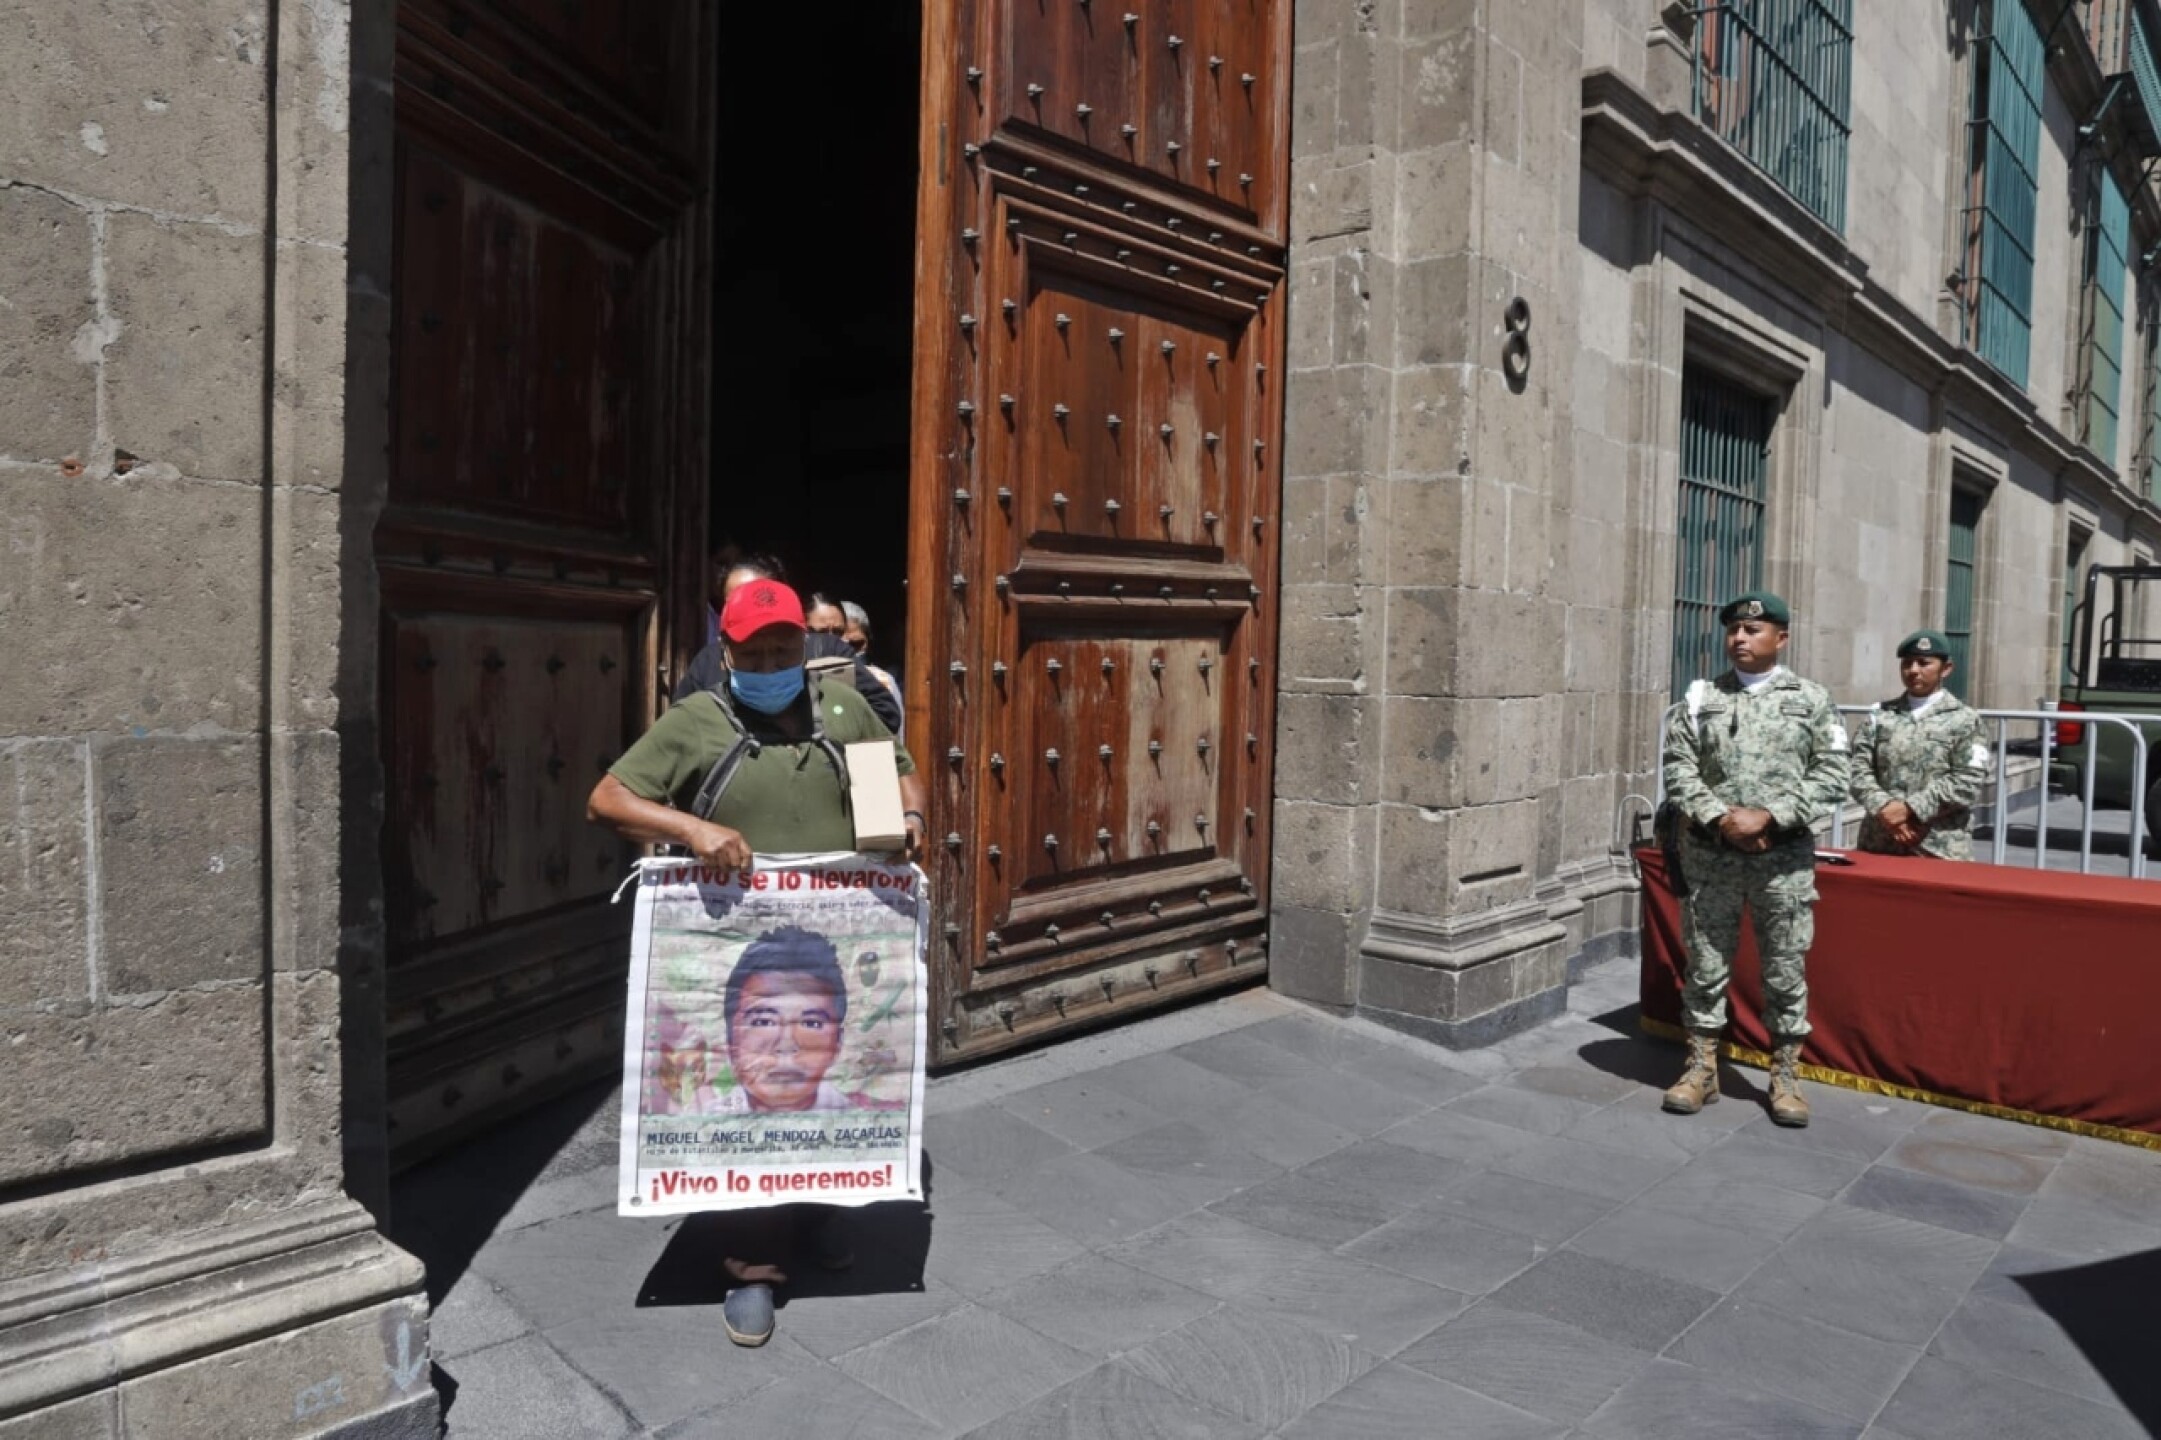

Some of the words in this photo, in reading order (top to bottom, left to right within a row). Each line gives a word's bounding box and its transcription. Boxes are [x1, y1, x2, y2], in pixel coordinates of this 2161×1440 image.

[1502, 296, 1531, 392] 8
[738, 871, 768, 891] se
[777, 869, 801, 890] lo
[647, 1132, 701, 1145] MIGUEL
[711, 1129, 755, 1143] ÁNGEL
[764, 1128, 827, 1142] MENDOZA
[834, 1124, 902, 1140] ZACARÍAS
[652, 1171, 718, 1201] ¡Vivo
[727, 1169, 751, 1193] lo
[759, 1164, 893, 1197] queremos!
